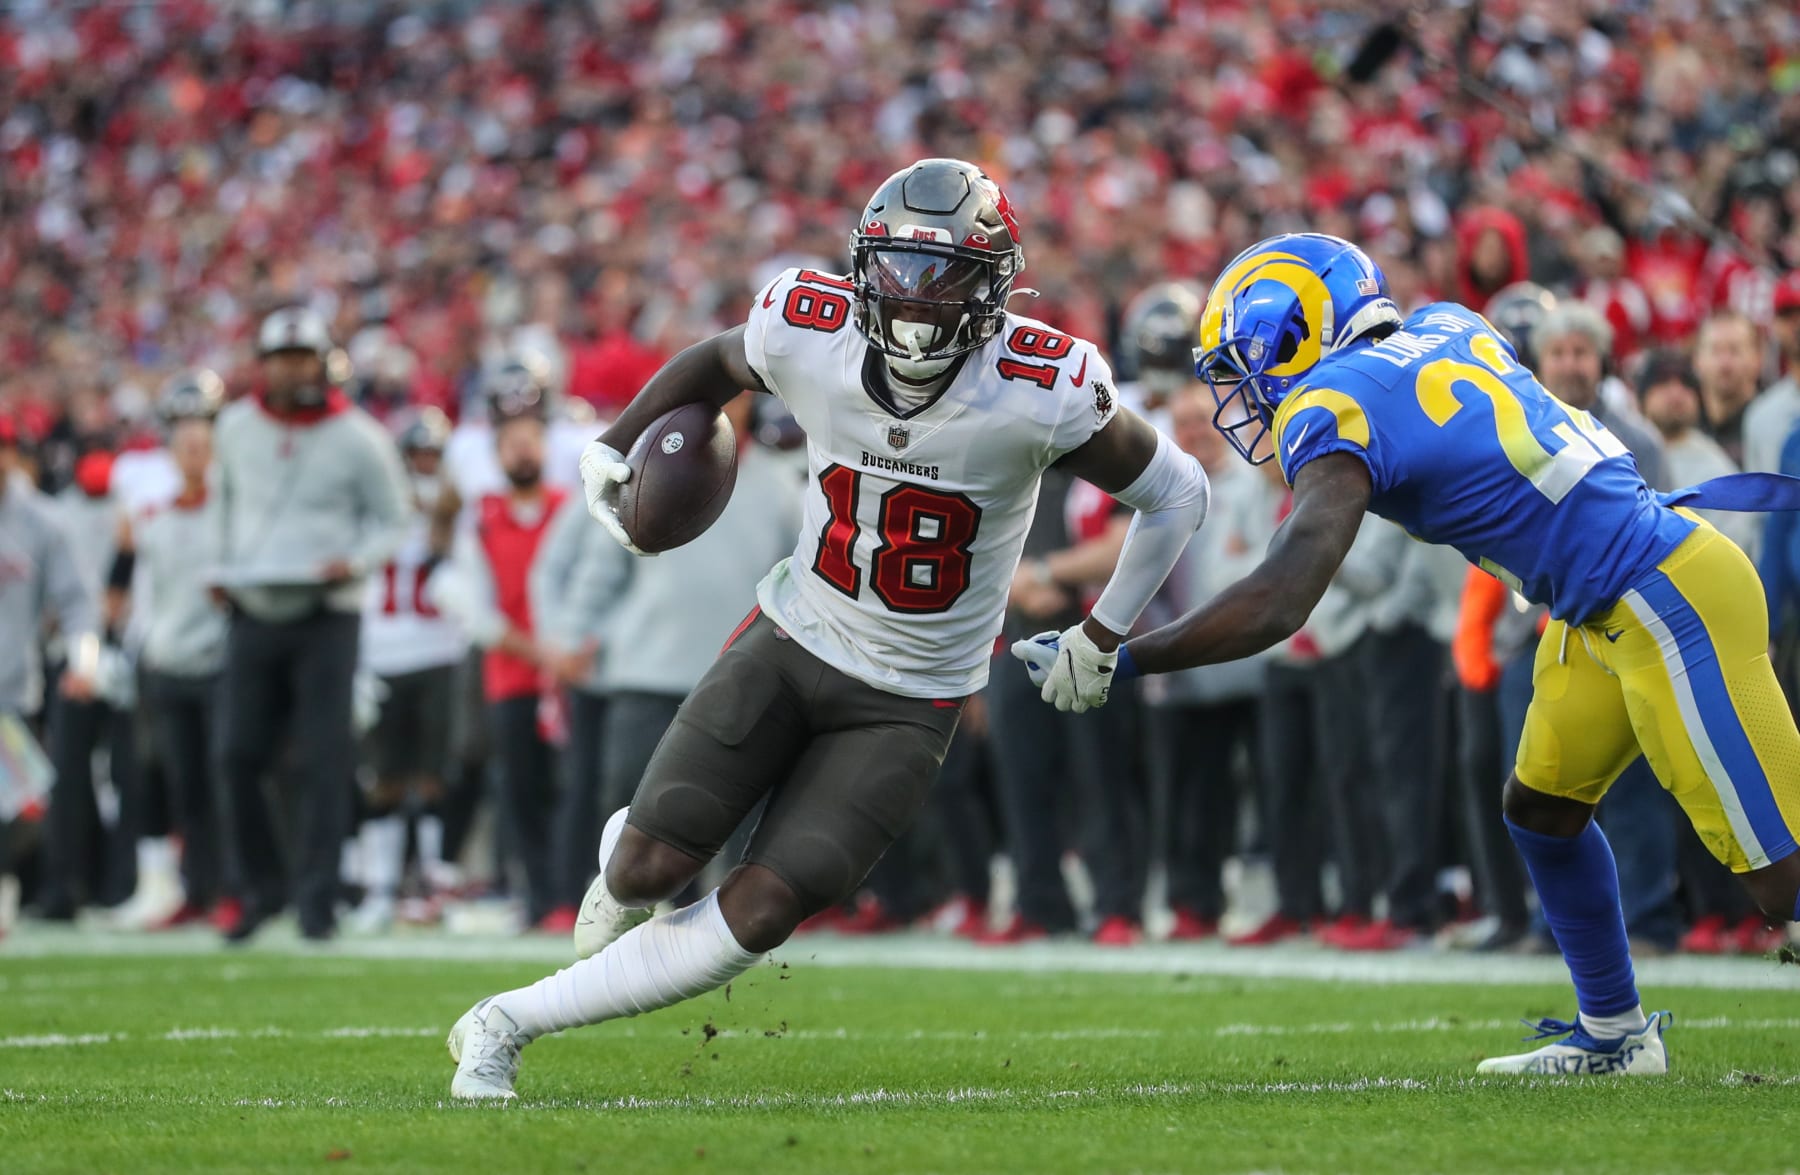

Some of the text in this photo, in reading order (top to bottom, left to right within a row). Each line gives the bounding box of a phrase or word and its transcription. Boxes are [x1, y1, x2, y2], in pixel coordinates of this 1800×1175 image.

[782, 269, 857, 333] 18
[997, 326, 1075, 391] 18
[890, 435, 906, 446] NFL
[1416, 333, 1630, 505] 22
[861, 451, 939, 480] BUCCANEERS
[811, 462, 983, 614] 18
